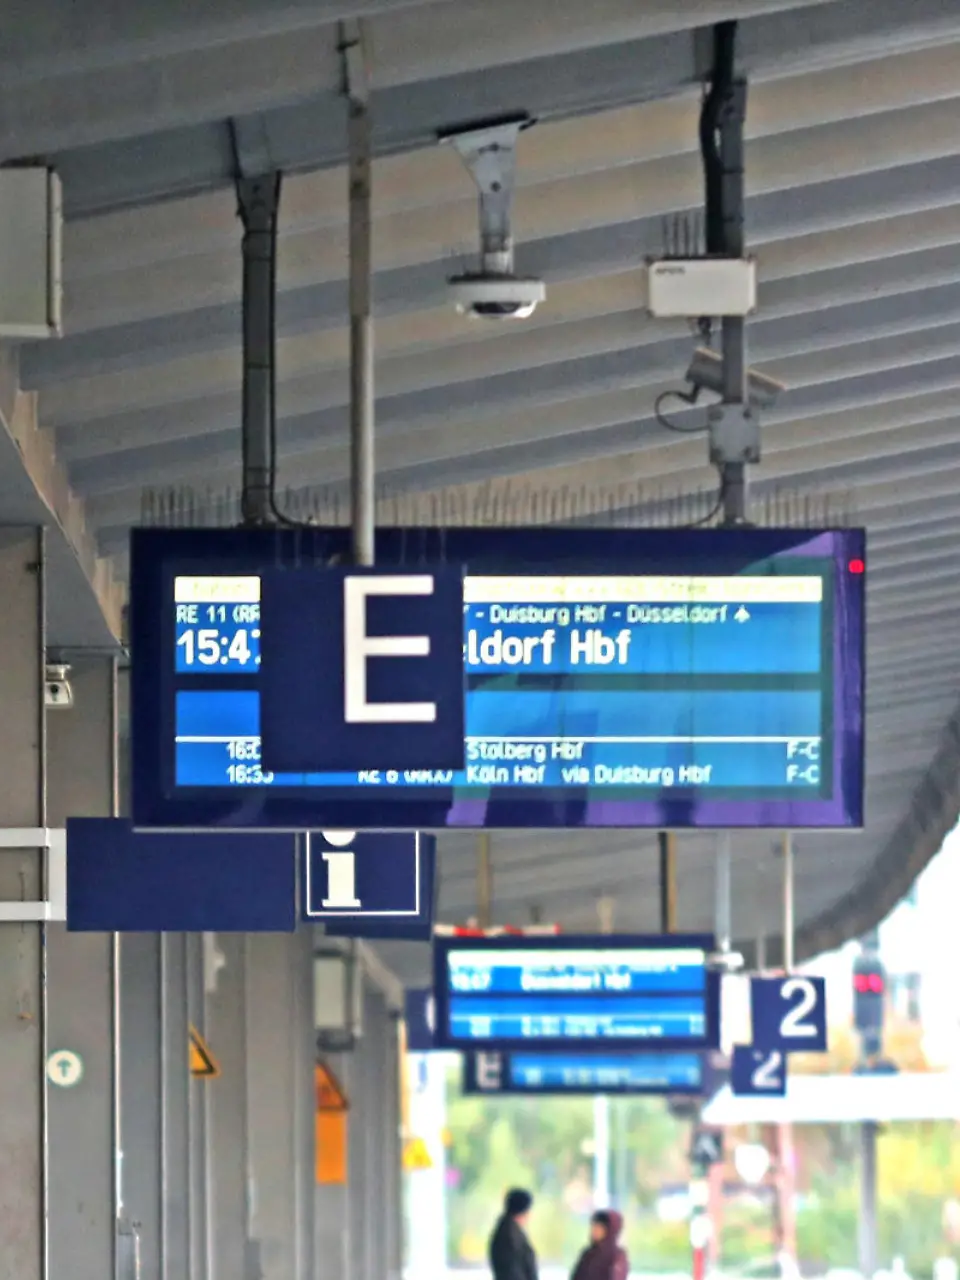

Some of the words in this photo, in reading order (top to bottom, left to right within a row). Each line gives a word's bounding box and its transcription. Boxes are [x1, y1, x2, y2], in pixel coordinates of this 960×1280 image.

[176, 604, 198, 624] RE
[206, 604, 226, 624] 11
[490, 604, 570, 626] Duisburg
[574, 604, 607, 622] Hbf
[626, 604, 728, 624] Düsseldorf
[344, 574, 437, 723] E
[463, 629, 556, 665] ldorf
[570, 629, 632, 665] Hbf
[466, 742, 547, 763] Stolberg
[551, 742, 585, 760] Hbf
[513, 764, 546, 784] Hbf
[561, 766, 590, 784] via
[594, 764, 674, 786] Duisburg
[678, 764, 712, 784] Hbf
[780, 978, 818, 1037] 2
[751, 1049, 782, 1089] 2
